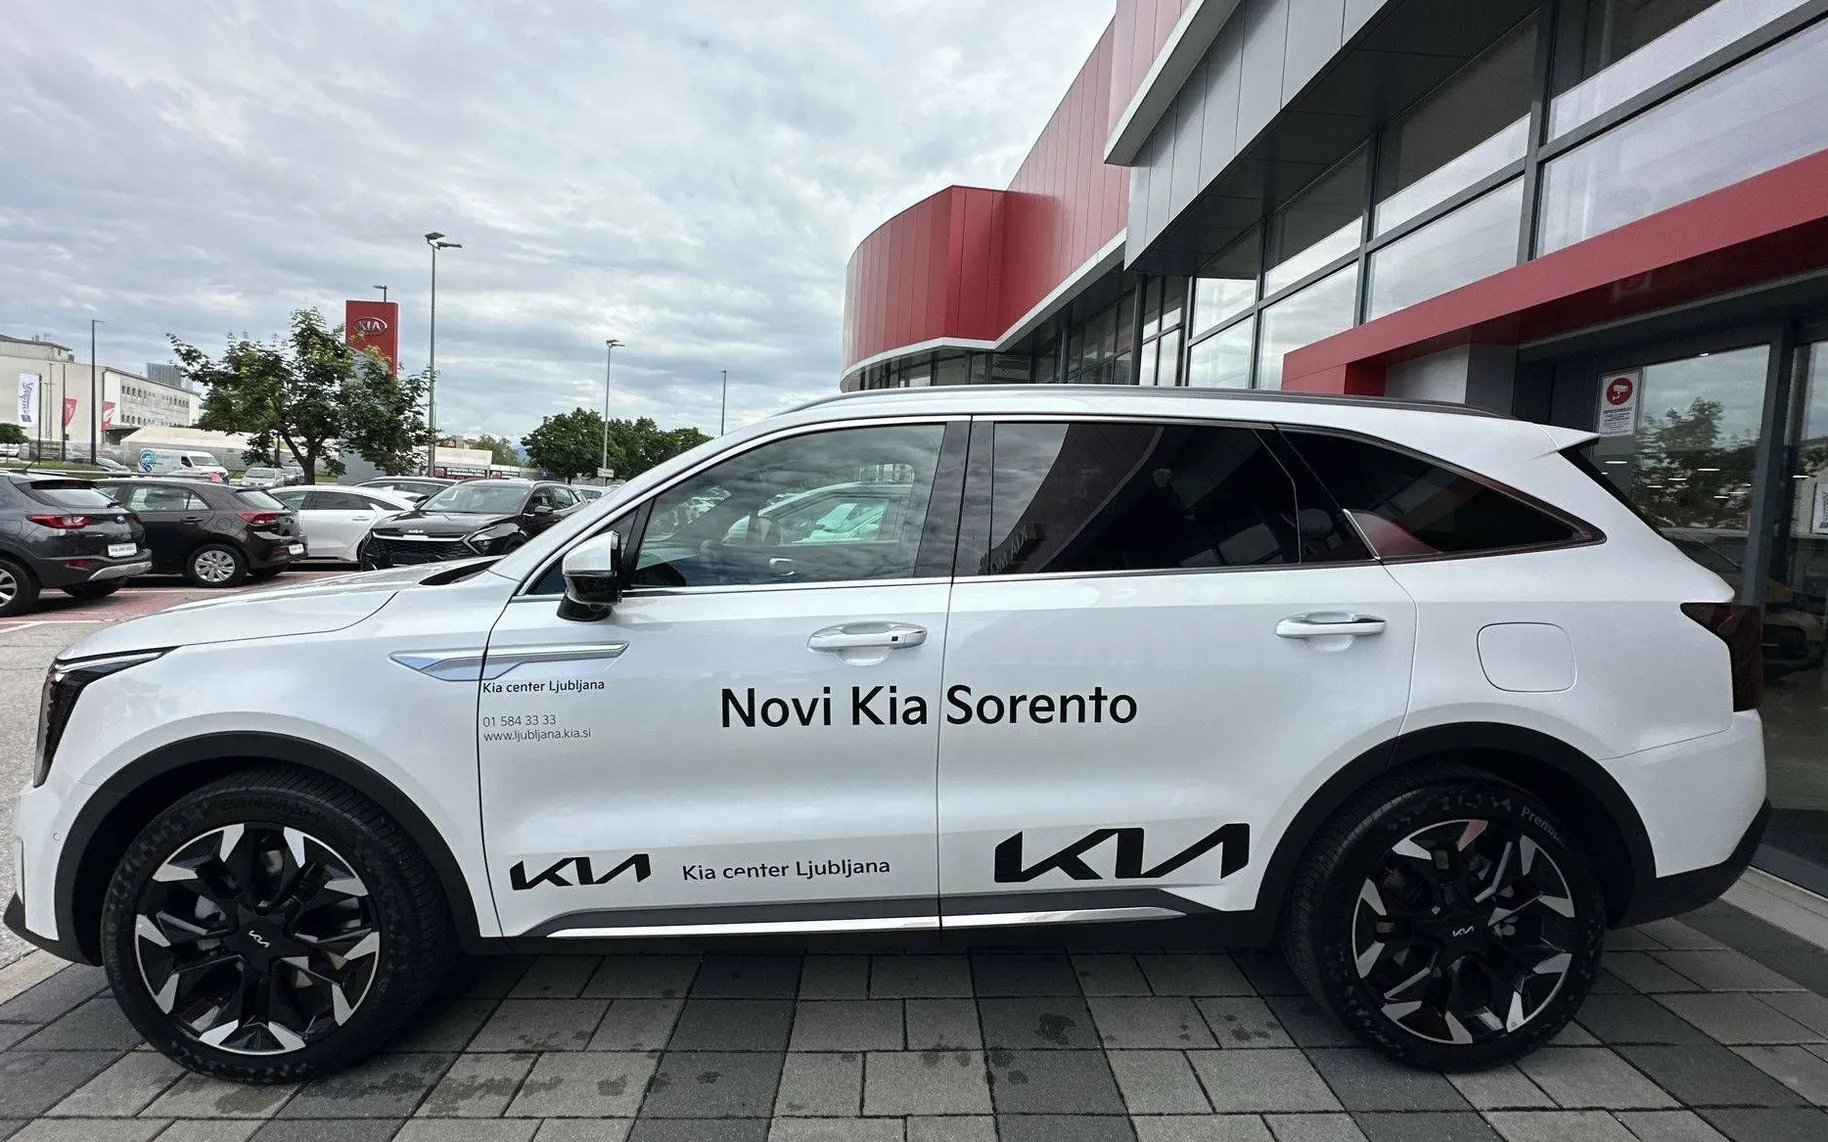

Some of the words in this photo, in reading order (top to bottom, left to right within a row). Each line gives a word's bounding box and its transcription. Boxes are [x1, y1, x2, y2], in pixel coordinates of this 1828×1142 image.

[358, 320, 382, 331] KIA
[483, 683, 502, 693] Kia
[506, 682, 545, 693] center
[549, 680, 605, 693] Ljubljana
[722, 687, 830, 728] Novi
[853, 686, 928, 726] Kia
[946, 685, 1137, 725] Sorento
[482, 716, 496, 727] 01
[500, 715, 523, 727] 584
[524, 714, 540, 726] 33
[541, 714, 558, 725] 33
[483, 727, 592, 743] www.ljubljana.kia.si
[994, 823, 1250, 883] KIA
[510, 853, 652, 891] KIA
[683, 864, 716, 881] Kia
[796, 859, 890, 880] Ljubljana
